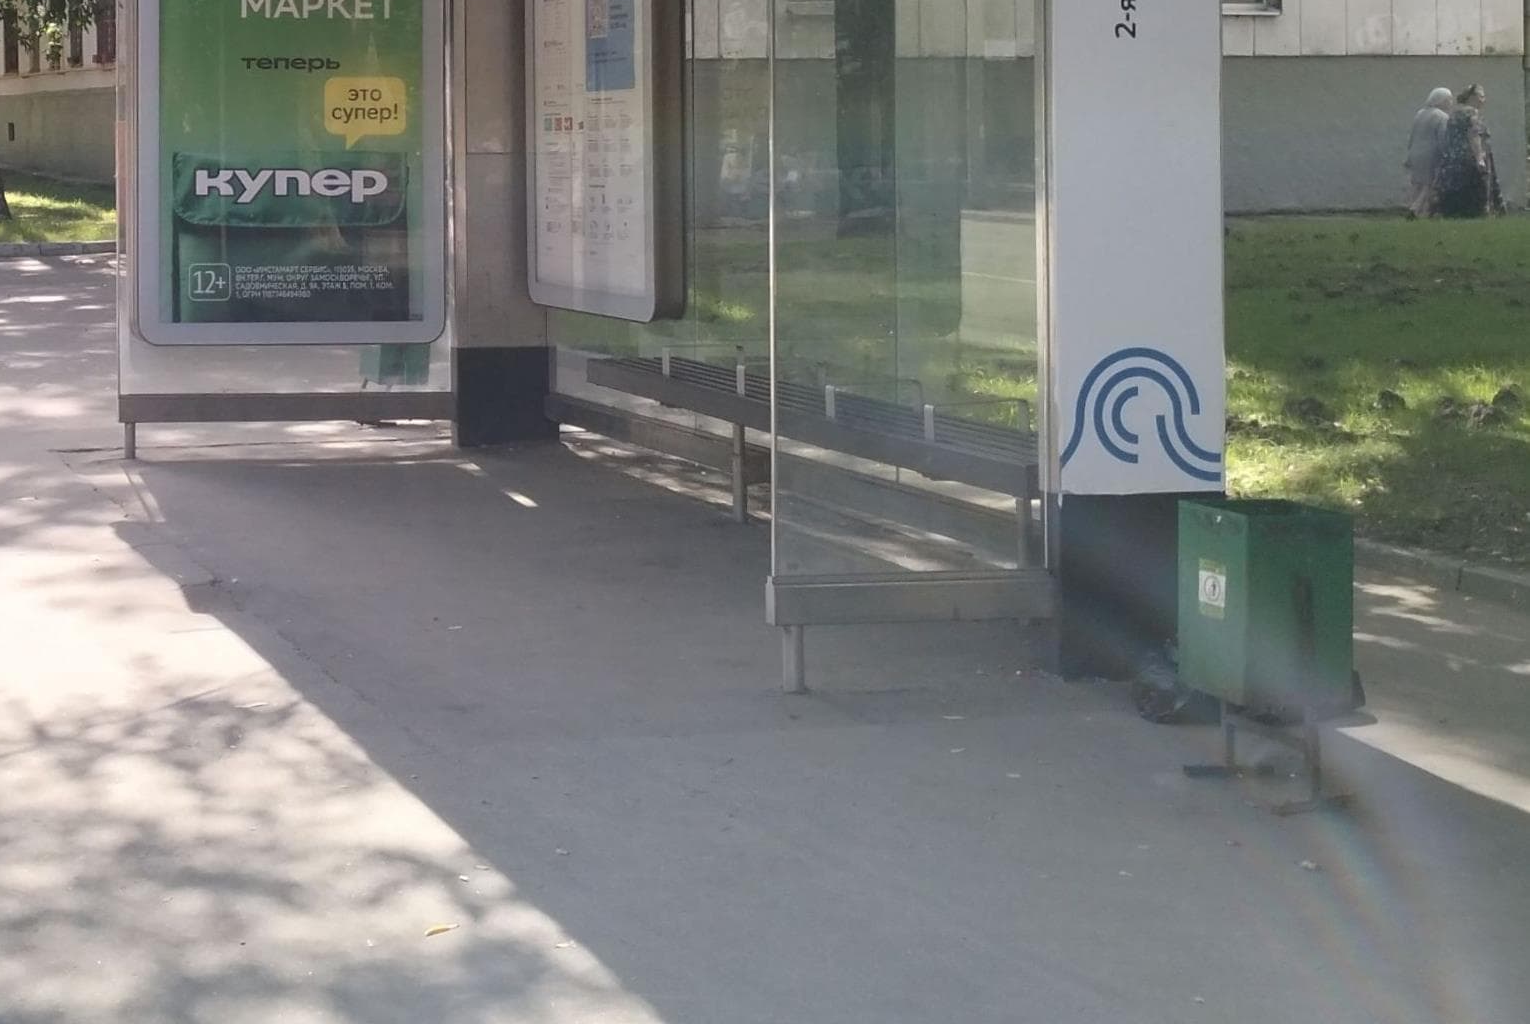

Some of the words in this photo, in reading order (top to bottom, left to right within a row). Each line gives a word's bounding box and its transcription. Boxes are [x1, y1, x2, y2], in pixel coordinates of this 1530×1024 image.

[241, 56, 341, 73] теперь
[347, 88, 383, 102] это
[331, 103, 399, 124] супер!
[194, 169, 389, 204] купер
[192, 269, 226, 295] 12+
